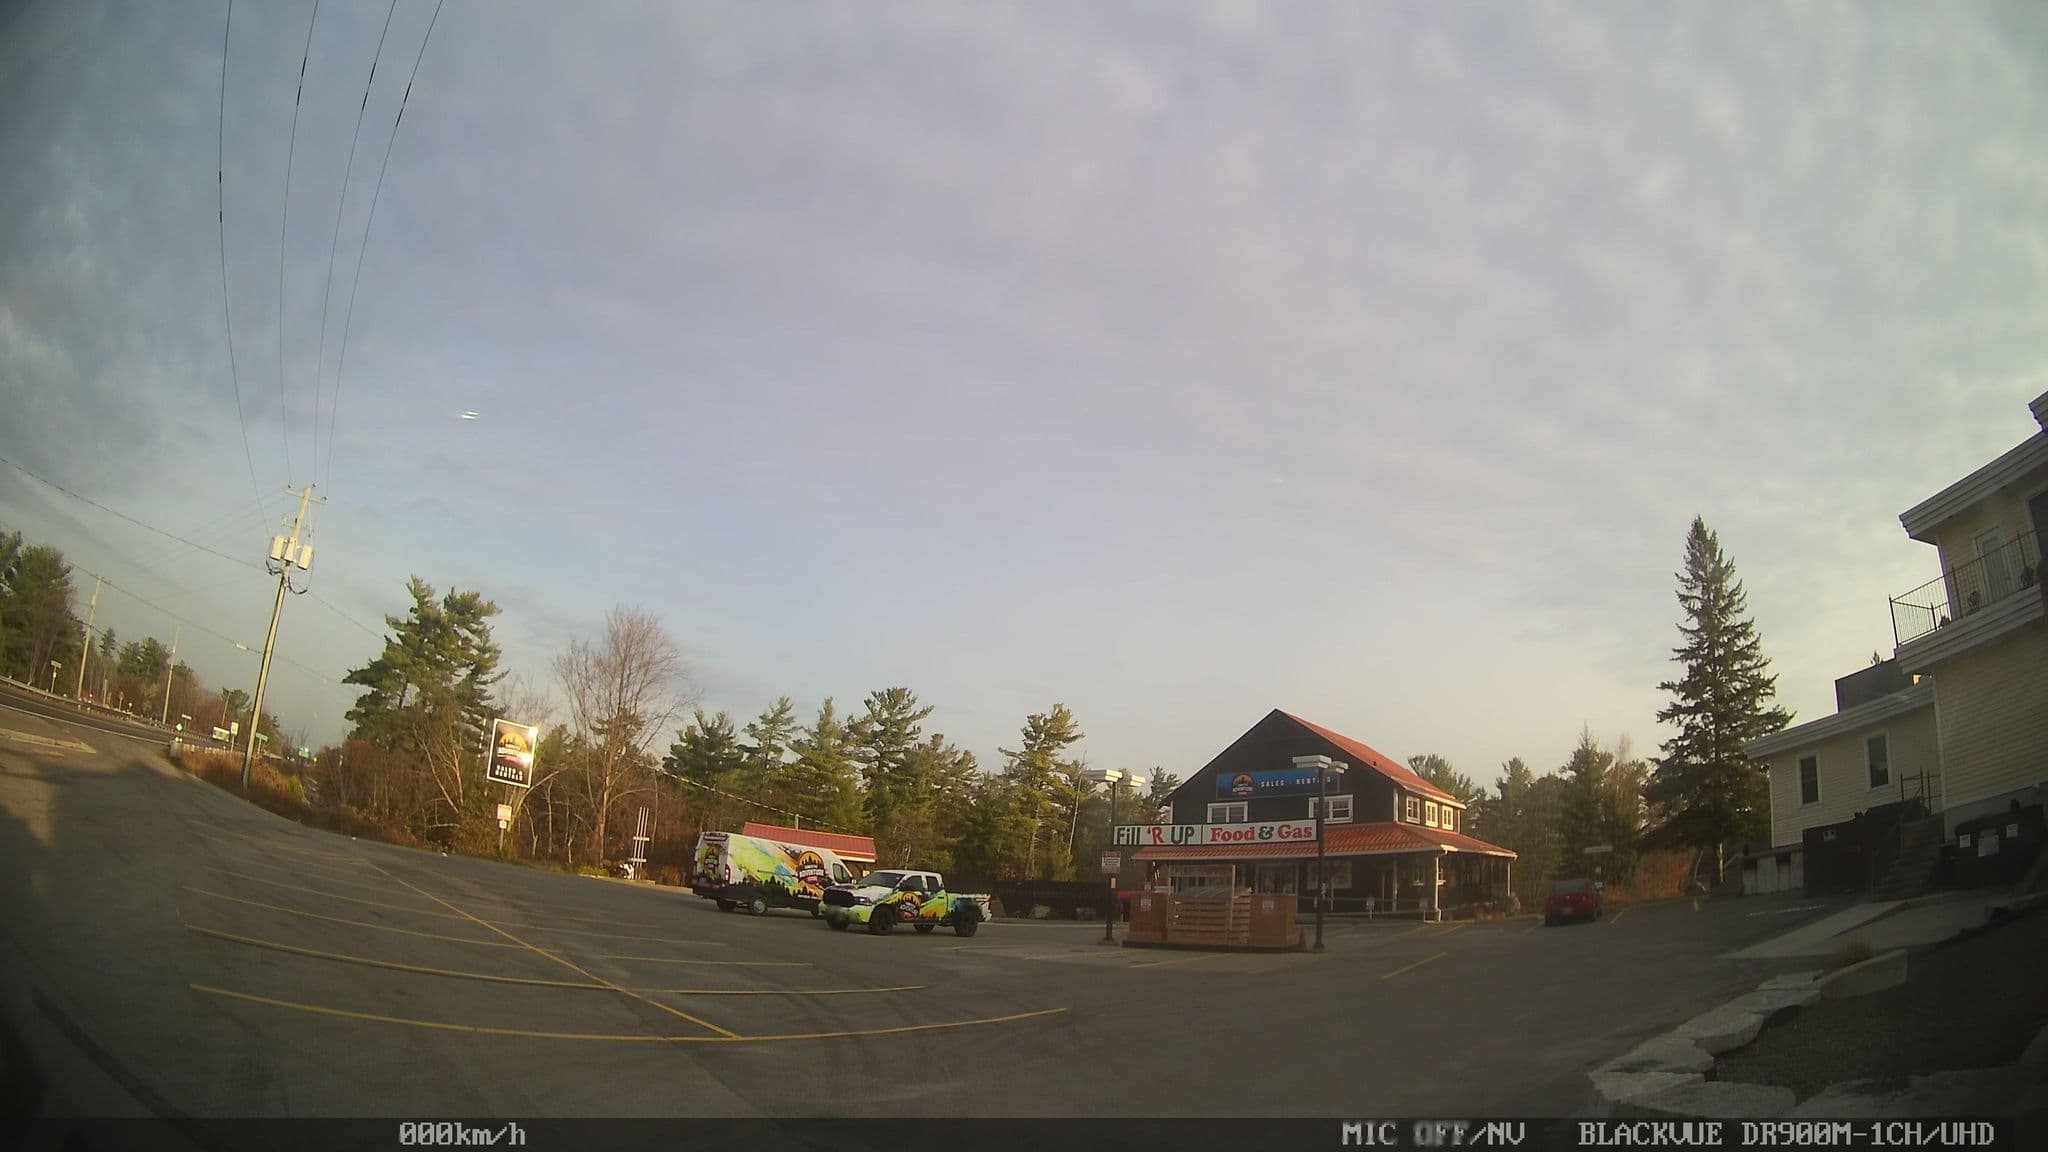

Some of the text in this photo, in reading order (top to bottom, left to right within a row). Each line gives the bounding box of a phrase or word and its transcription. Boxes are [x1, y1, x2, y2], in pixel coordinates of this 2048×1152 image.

[1296, 776, 1332, 785] RENTS
[1116, 826, 1195, 846] Fill 'R UP
[1210, 823, 1313, 843] Food & Gas
